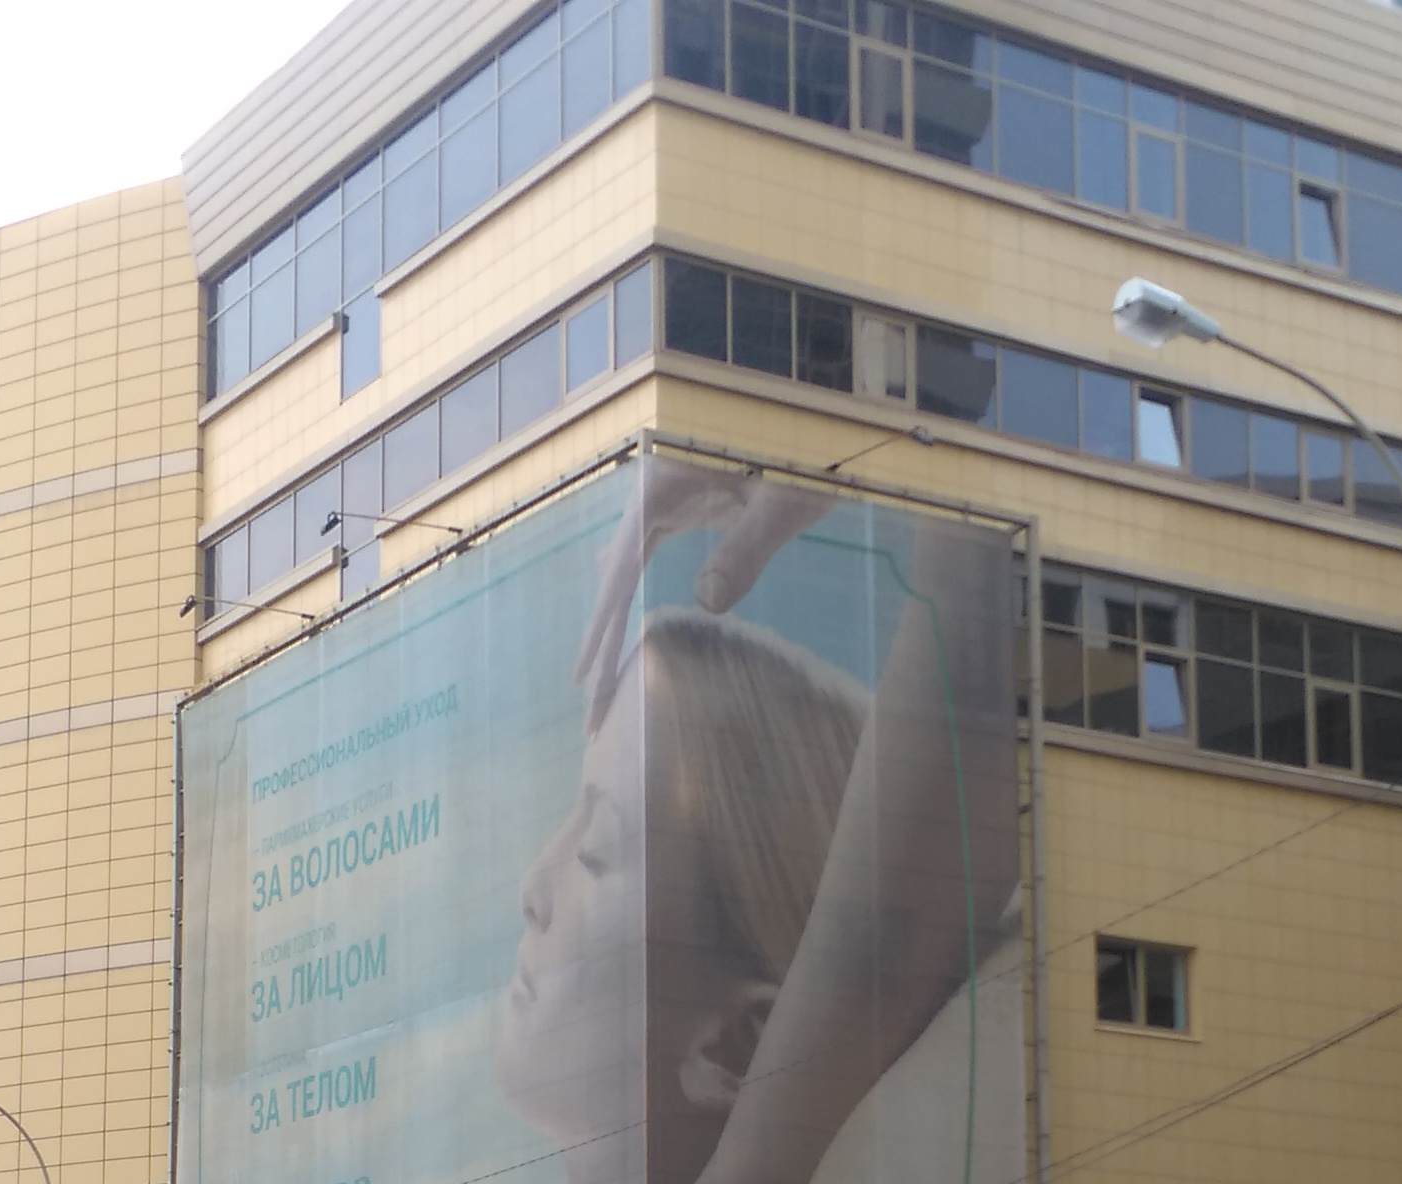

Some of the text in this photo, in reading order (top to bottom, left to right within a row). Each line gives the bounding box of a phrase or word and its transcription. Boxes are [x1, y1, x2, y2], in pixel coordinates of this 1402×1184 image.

[252, 685, 459, 803] ПРОФЕССИОНАЛЬНЫЙ УХОД
[252, 793, 440, 912] ЗА ВОЛОСАМИ
[251, 933, 387, 1023] ЗА ЛИЦОМ
[250, 1088, 280, 1134] ЗА
[287, 1056, 376, 1122] ТЕЛОМ
